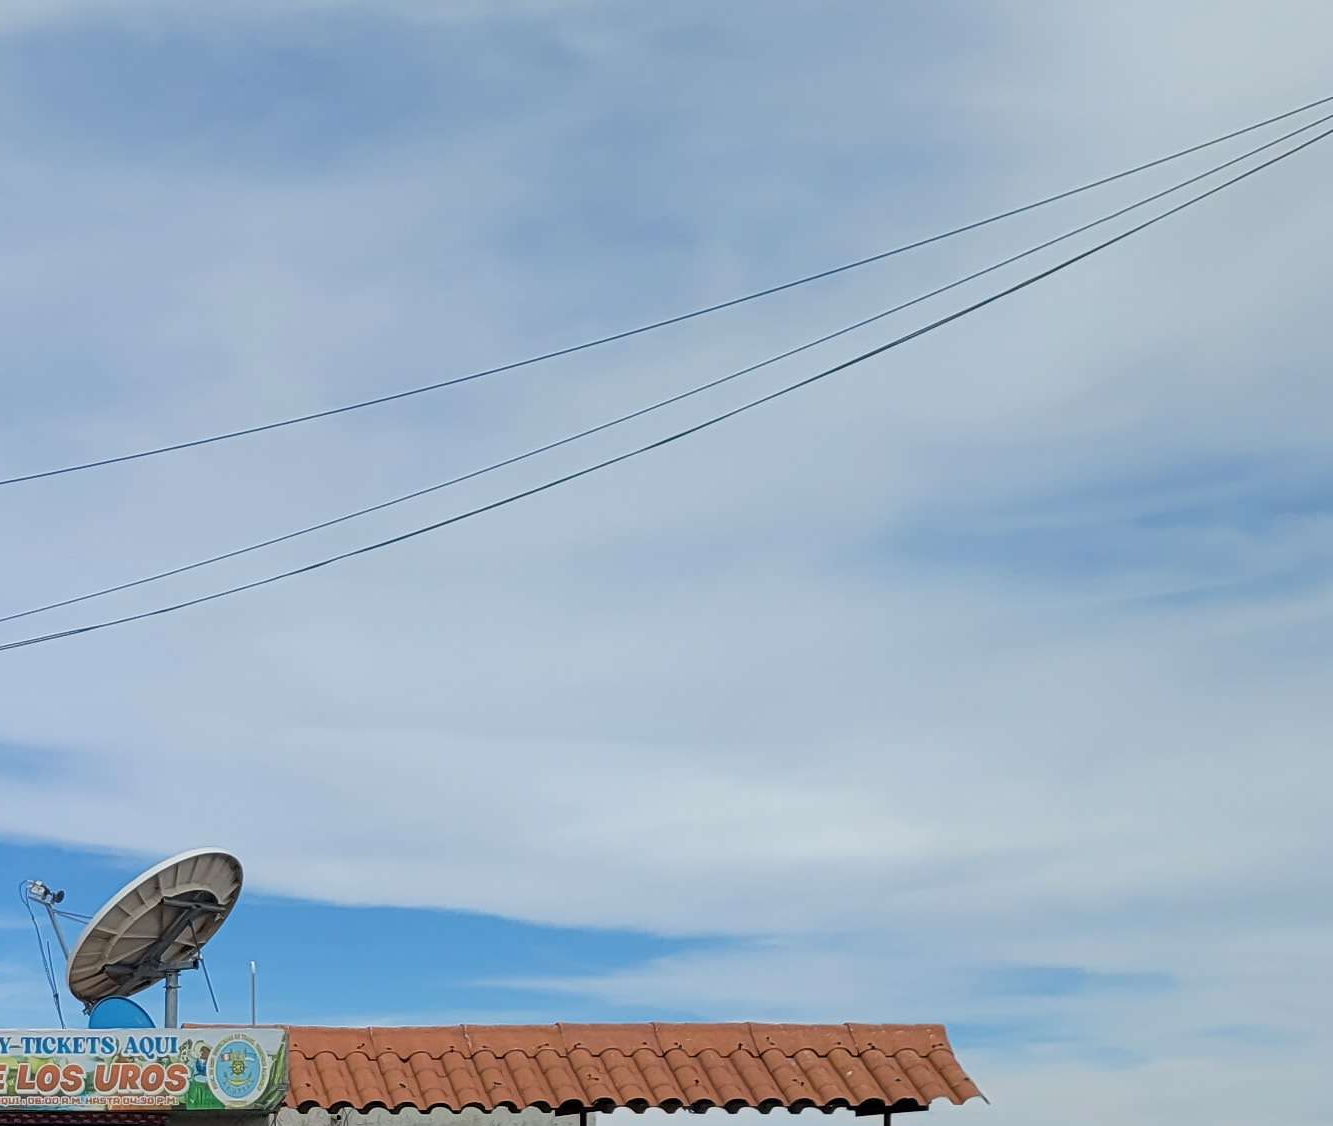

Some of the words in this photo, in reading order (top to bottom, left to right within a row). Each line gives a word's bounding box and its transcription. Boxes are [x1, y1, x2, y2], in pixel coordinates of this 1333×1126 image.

[20, 1036, 113, 1054] TICKETS
[124, 1036, 178, 1058] AQUI
[17, 1063, 84, 1091] LOS
[95, 1063, 189, 1091] UROS
